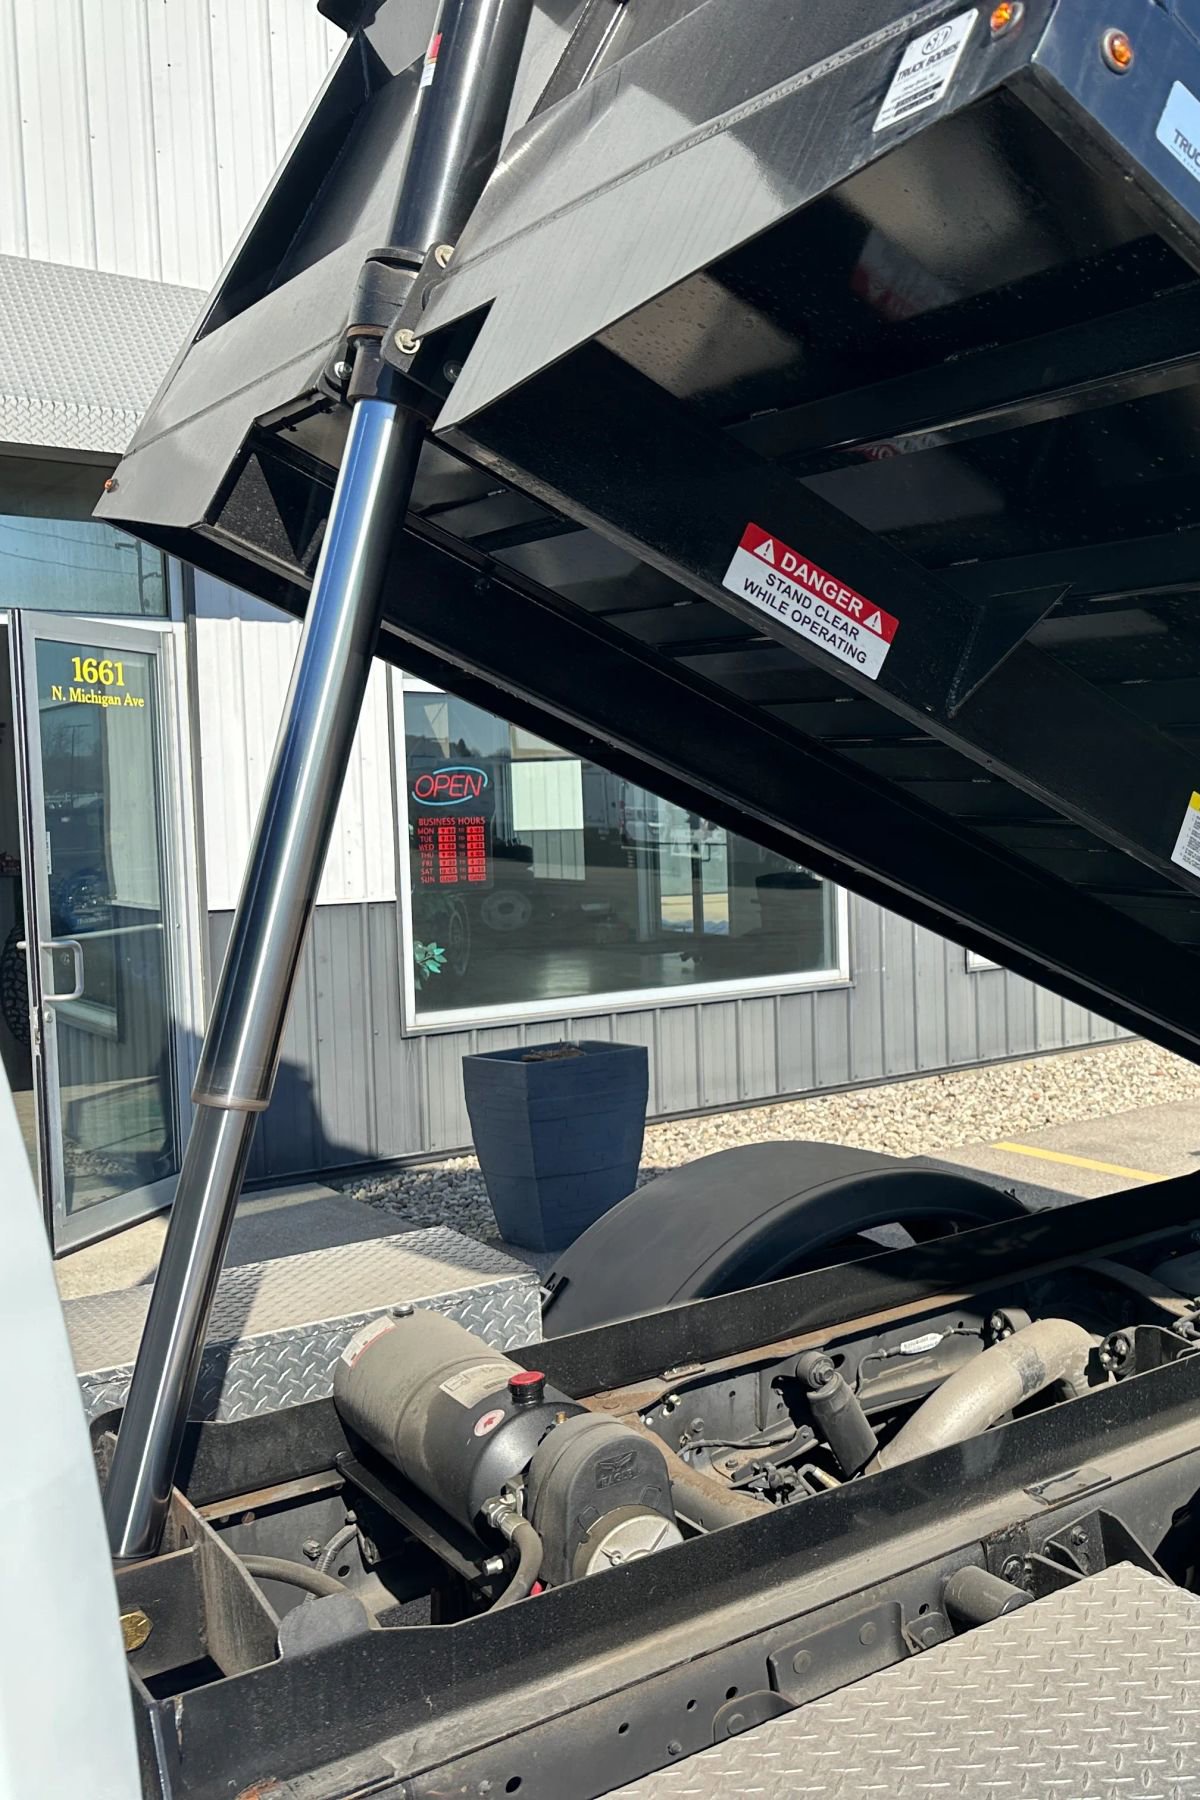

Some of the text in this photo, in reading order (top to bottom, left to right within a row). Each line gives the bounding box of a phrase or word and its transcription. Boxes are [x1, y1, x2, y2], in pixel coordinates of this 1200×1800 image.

[780, 552, 863, 618] DANGER
[765, 573, 860, 640] STAND CLEAR
[743, 578, 867, 664] WHILE OPERATING
[72, 656, 125, 686] 1661
[51, 685, 145, 707] N. Michigan Ave
[415, 775, 482, 798] OPEN
[417, 827, 434, 835] MON
[418, 816, 485, 826] BUSINESS HOURS
